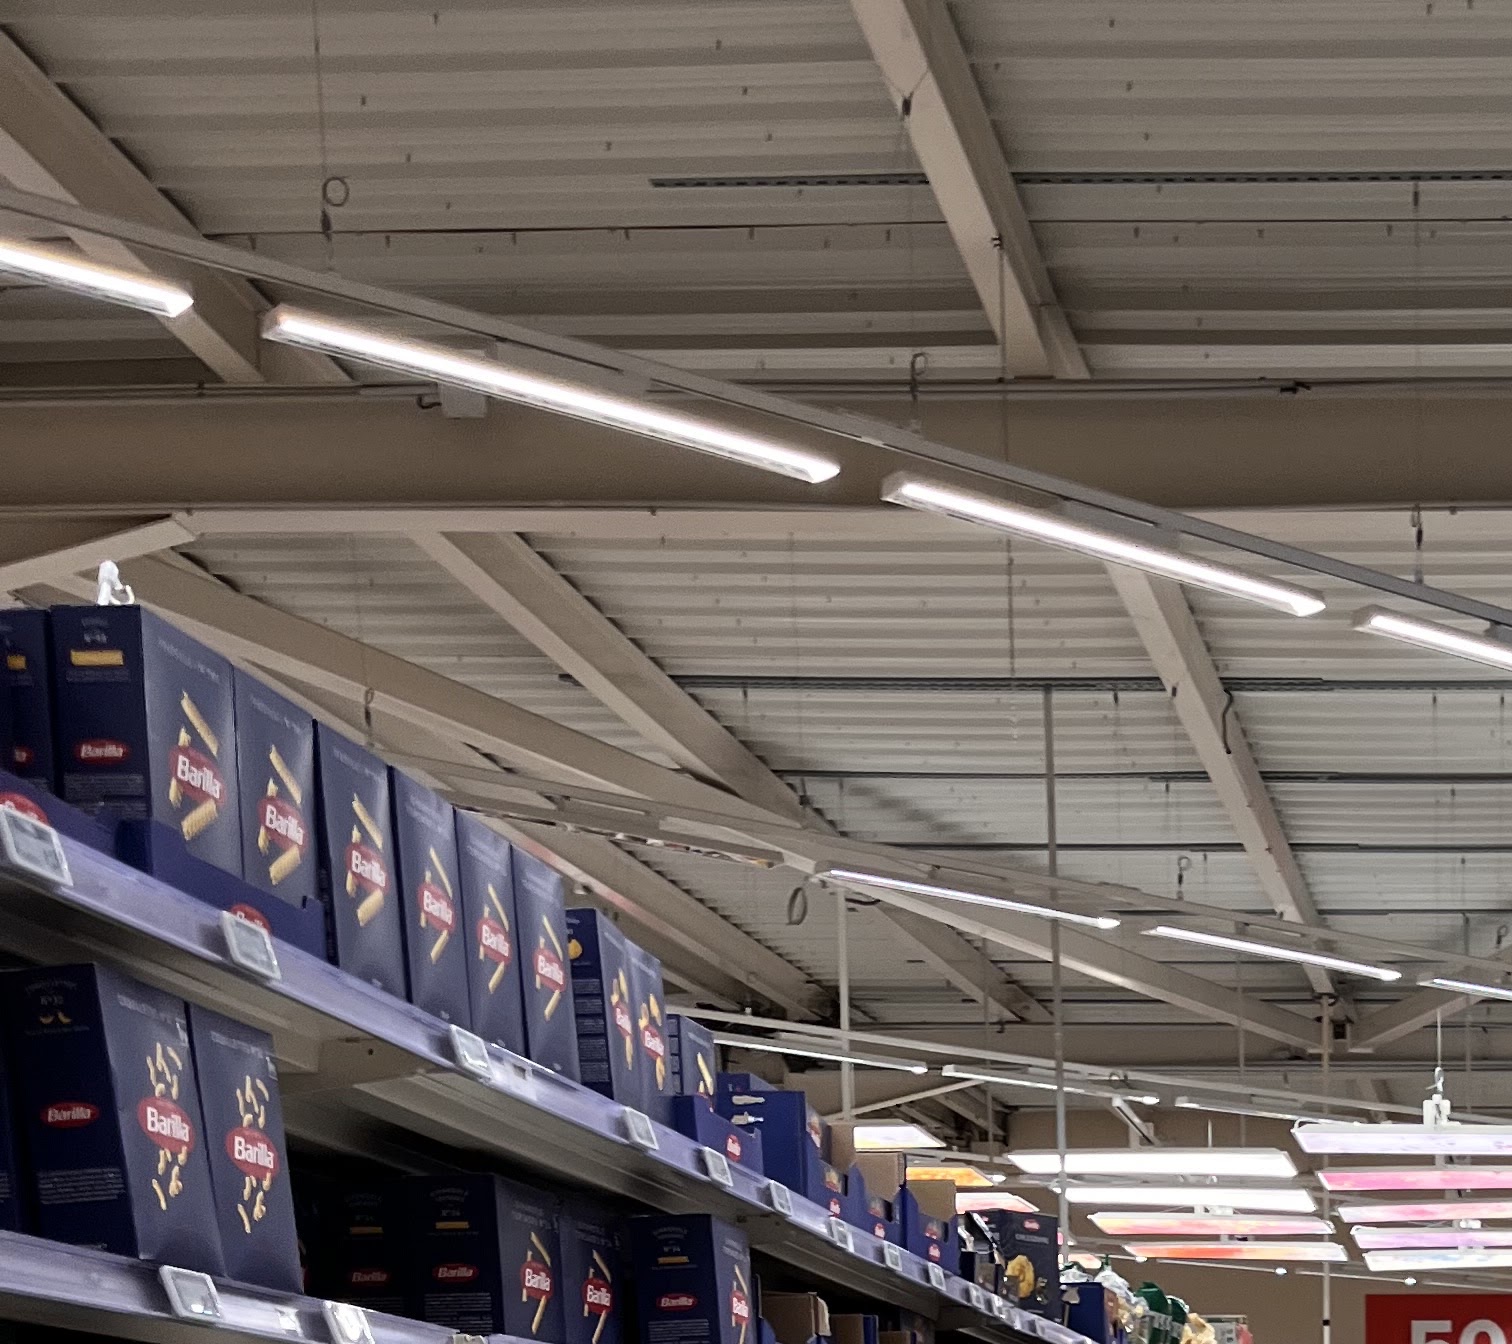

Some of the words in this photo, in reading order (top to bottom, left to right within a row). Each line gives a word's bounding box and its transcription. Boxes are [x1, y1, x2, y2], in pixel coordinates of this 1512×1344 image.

[80, 743, 124, 759] Barilla
[176, 755, 223, 801] Barilla
[264, 804, 305, 847] Barilla
[350, 849, 386, 888] Barilla
[422, 890, 453, 926] Barilla
[481, 924, 509, 958] Barilla
[48, 1105, 92, 1123] Barilla
[146, 1105, 191, 1143] Barilla
[233, 1135, 275, 1170] Barilla
[437, 1265, 474, 1279] Barilla
